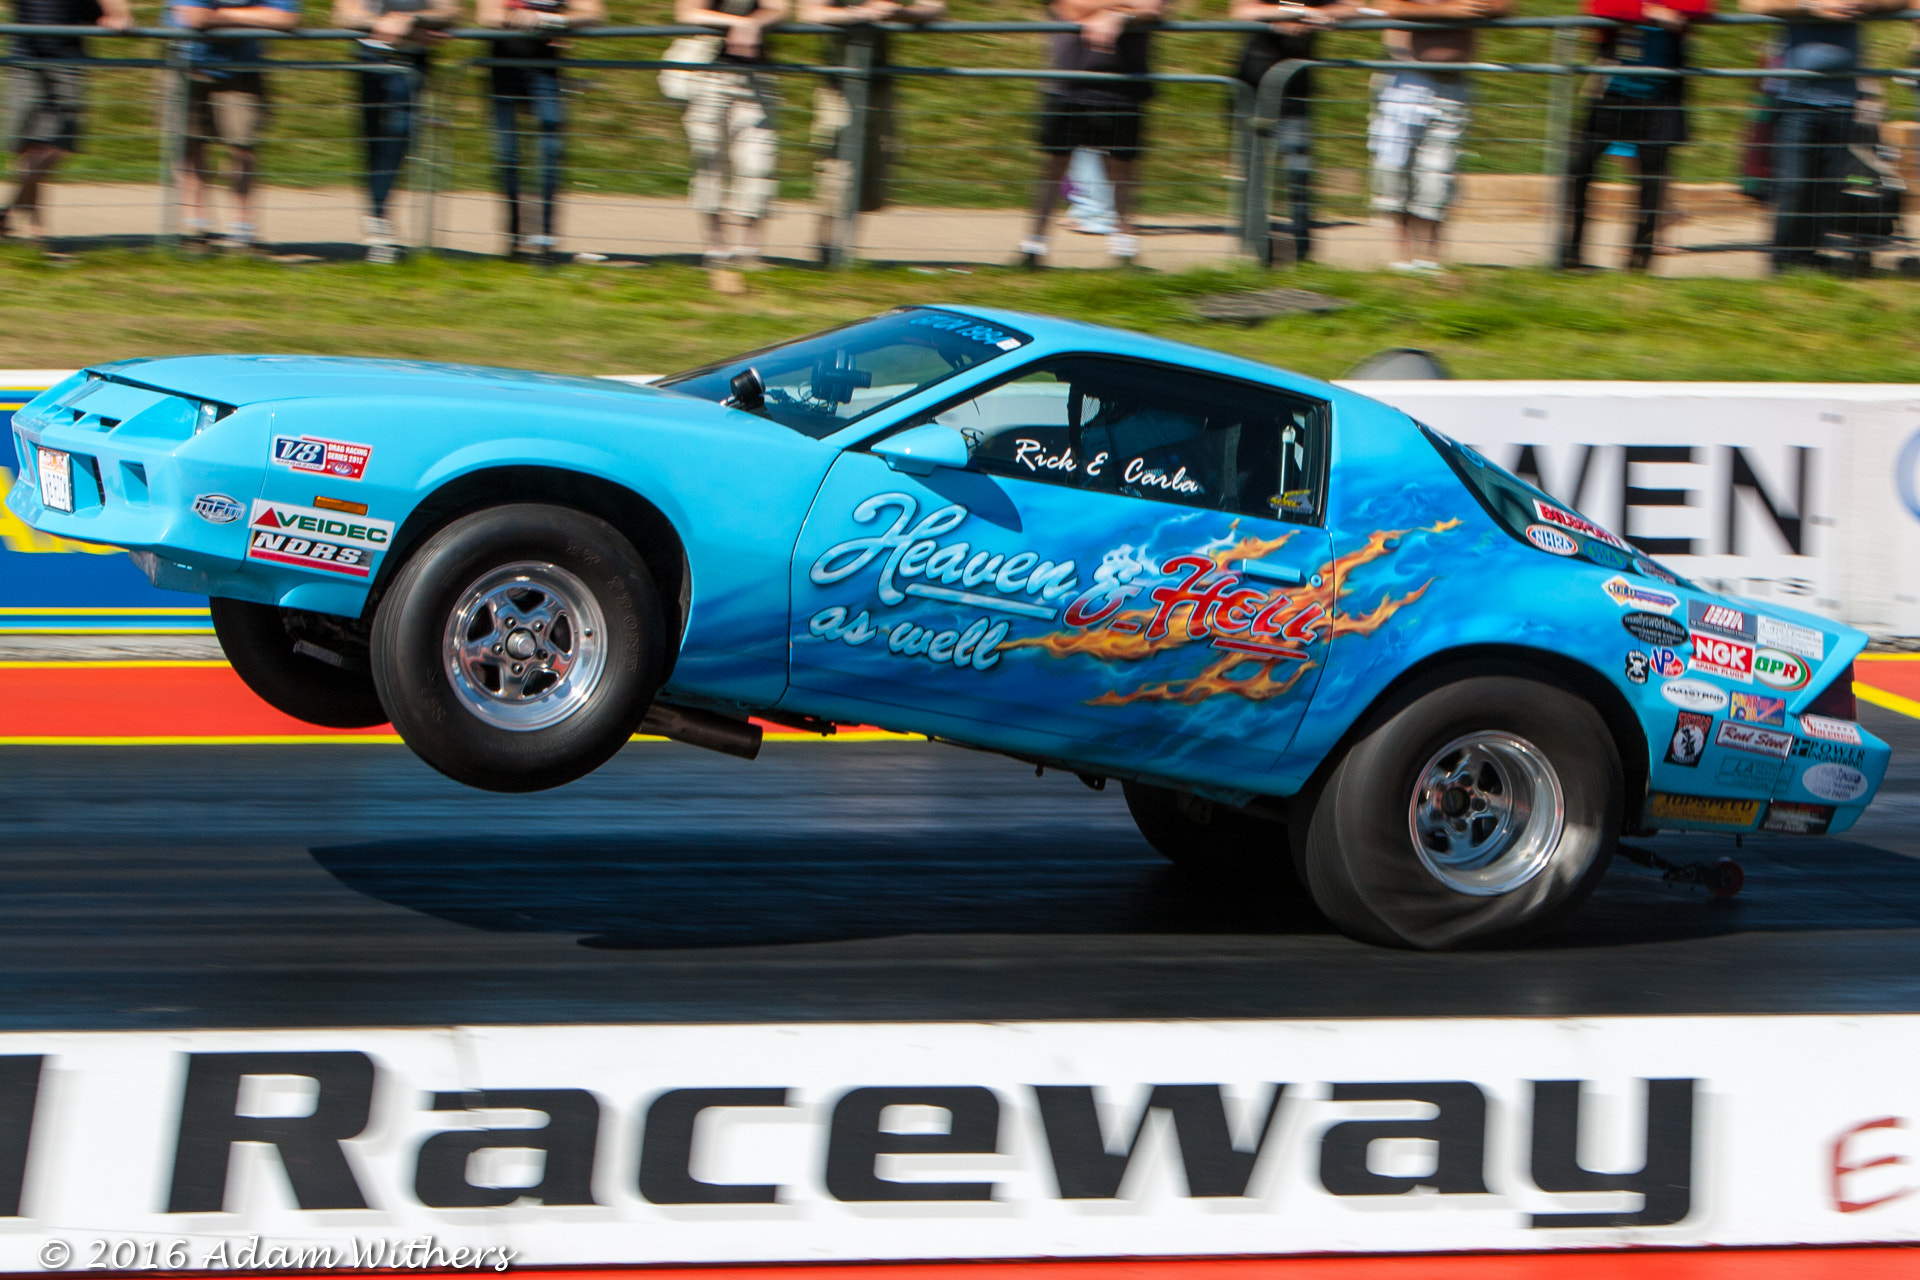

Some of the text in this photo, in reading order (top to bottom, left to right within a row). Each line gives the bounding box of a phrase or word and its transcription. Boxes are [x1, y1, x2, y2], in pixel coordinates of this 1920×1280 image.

[278, 439, 323, 462] V8
[327, 452, 364, 465] SERIES 2012
[328, 443, 368, 457] DRAG RACING
[1015, 438, 1077, 472] Rick
[1124, 457, 1198, 493] Carla
[276, 511, 388, 544] VEIDEC
[253, 532, 363, 565] NDRS
[809, 491, 1079, 606] Heaven
[1535, 530, 1571, 550] NHRA
[809, 606, 1010, 671] as well
[1651, 646, 1676, 676] VP
[1695, 637, 1747, 671] NGK
[1695, 662, 1745, 680] SPARK PLUGS
[1754, 656, 1798, 680] GPR
[1722, 726, 1755, 742] Real
[1808, 751, 1864, 769] ENGINEERING
[1810, 740, 1866, 761] POWER
[166, 1050, 1702, 1227] Raceway
